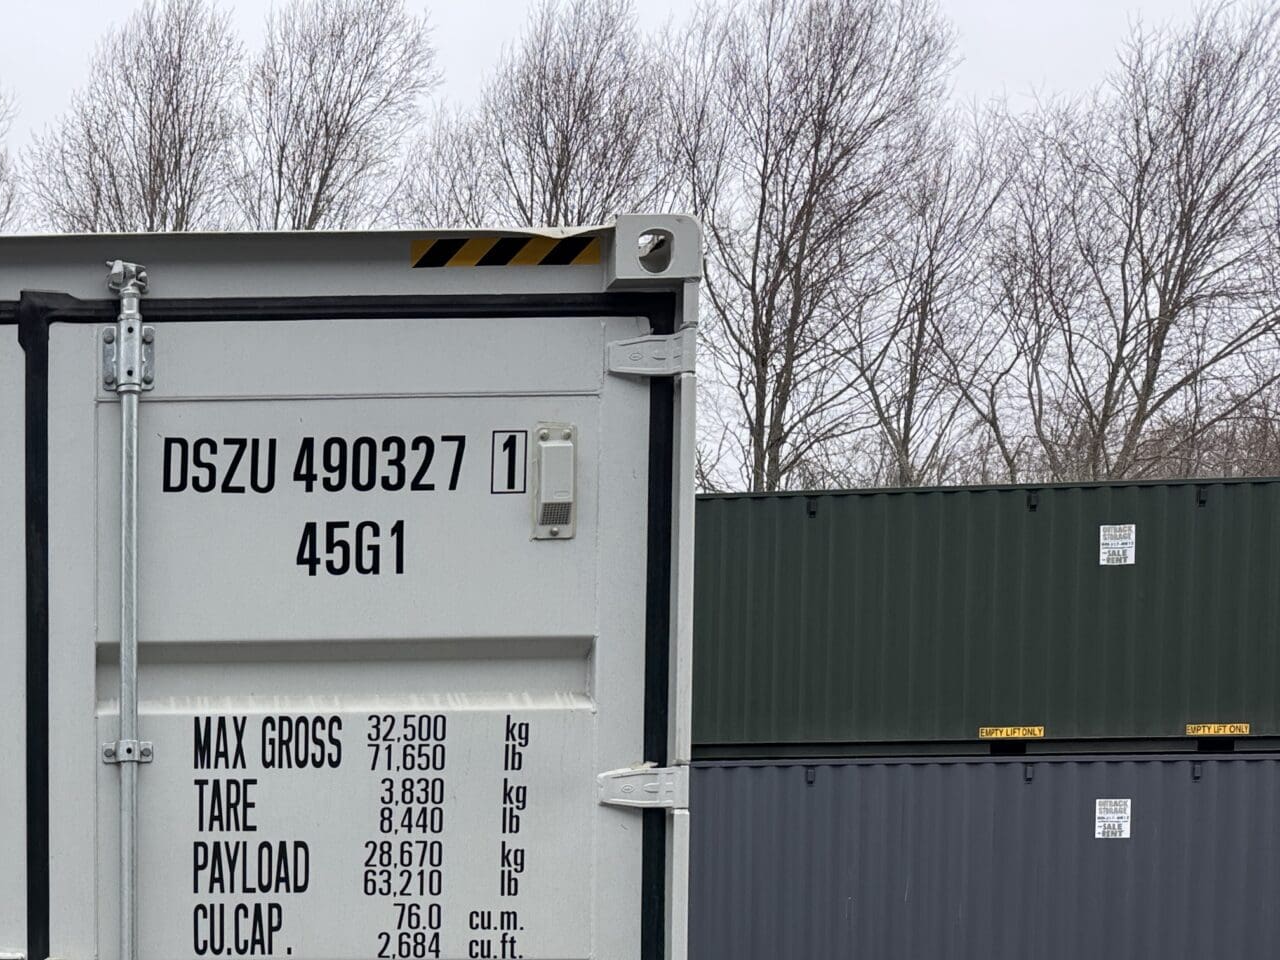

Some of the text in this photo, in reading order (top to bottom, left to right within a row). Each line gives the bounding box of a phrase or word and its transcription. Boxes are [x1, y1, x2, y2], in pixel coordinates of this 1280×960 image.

[162, 434, 517, 494] DSZU 490327 1
[296, 519, 405, 576] 45G1
[193, 714, 530, 769] MAX GROSS 32,500 kg
[980, 727, 1043, 737] EMPTY LIFT ONLY
[1229, 725, 1249, 733] ONLY
[367, 743, 523, 772] 71,650 lb
[194, 778, 527, 832] TARE 3,830 kg
[379, 807, 520, 835] 8,440 lb
[193, 840, 525, 894] PAYLOAD 28,670 kg
[363, 869, 519, 898] 63,210 lb
[393, 903, 442, 930] 76.0
[469, 910, 524, 930] cu.m.
[377, 932, 524, 960] 2,684 cu.ft.
